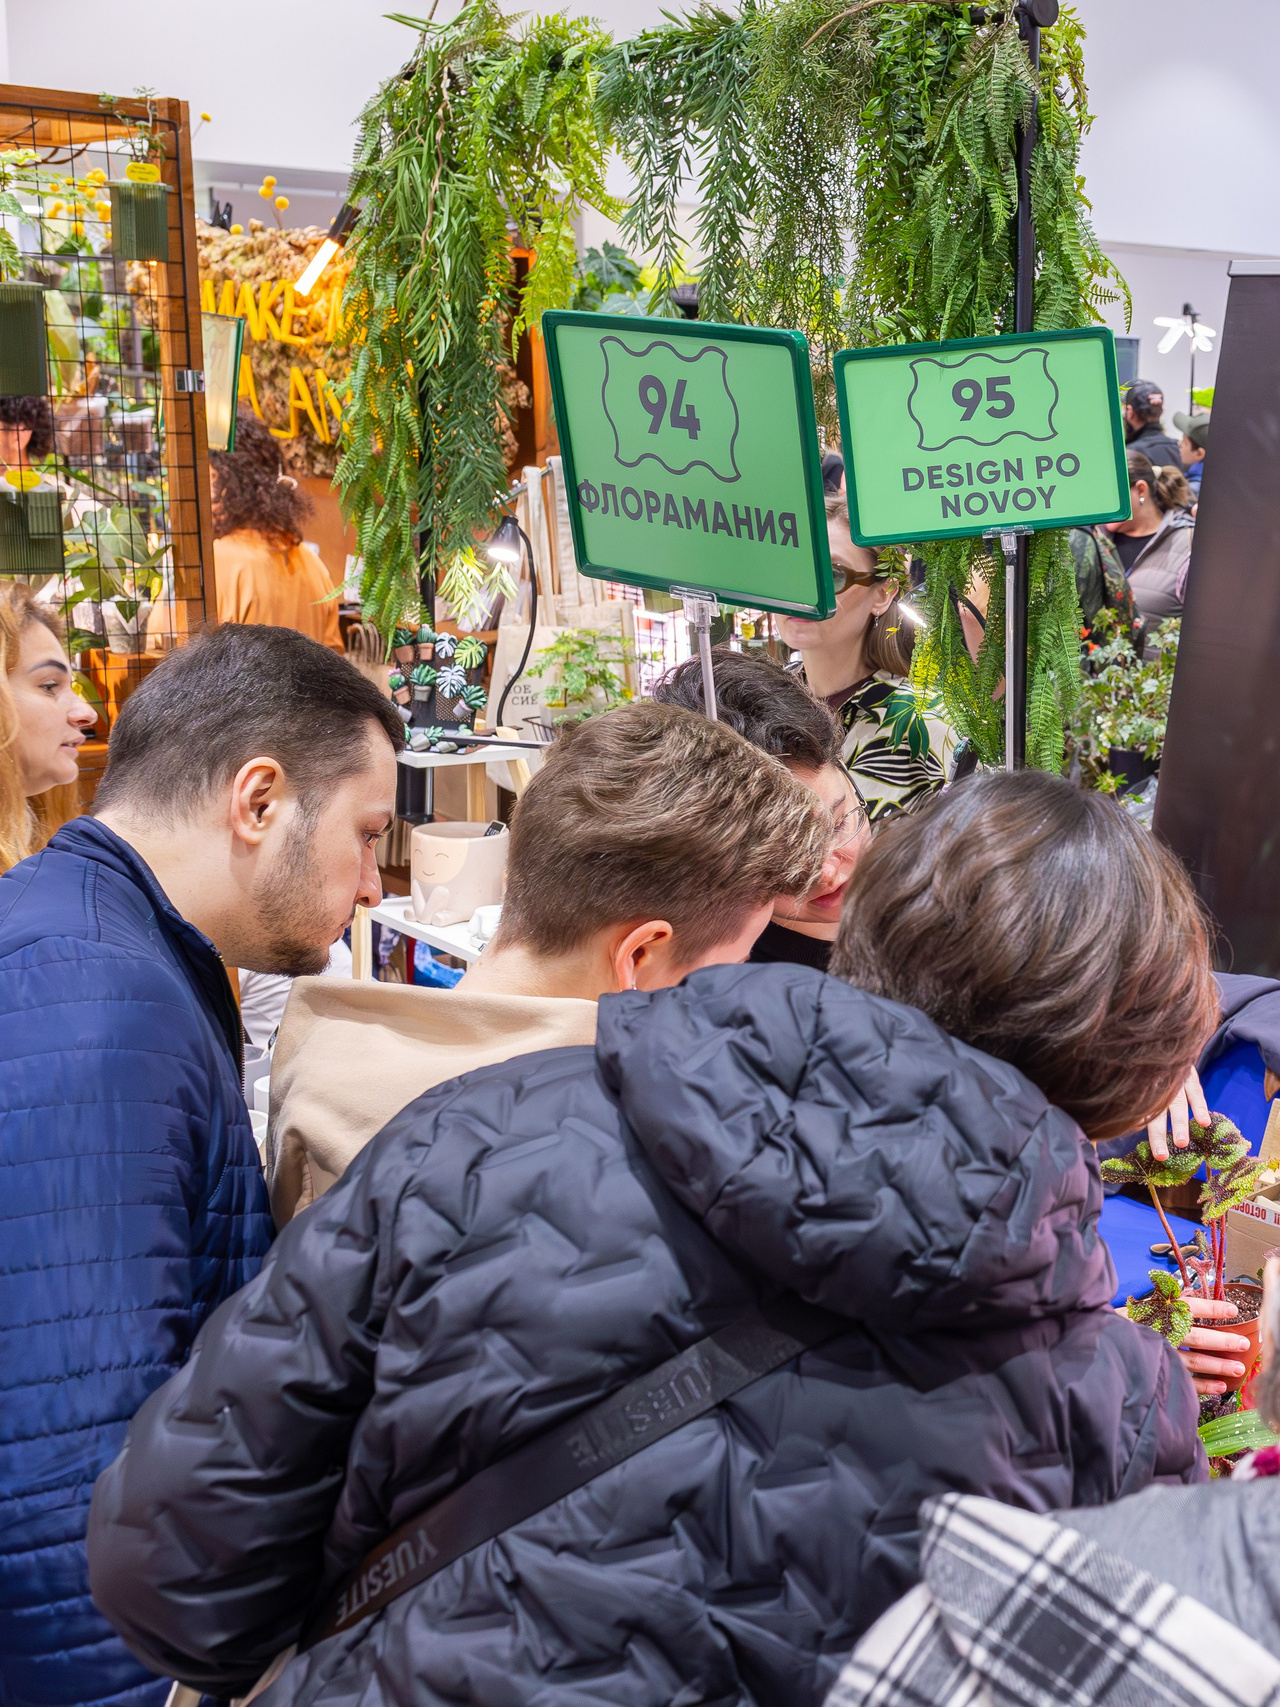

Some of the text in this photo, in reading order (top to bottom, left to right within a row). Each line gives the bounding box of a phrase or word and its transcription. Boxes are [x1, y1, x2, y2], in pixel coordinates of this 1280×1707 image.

[639, 373, 701, 440] 94
[951, 374, 1016, 423] 95
[902, 453, 1081, 493] DESIGN PO
[578, 479, 800, 548] ФЛОРАМАНИЯ
[941, 485, 1057, 520] NOVOY
[334, 1528, 440, 1627] YUESITE
